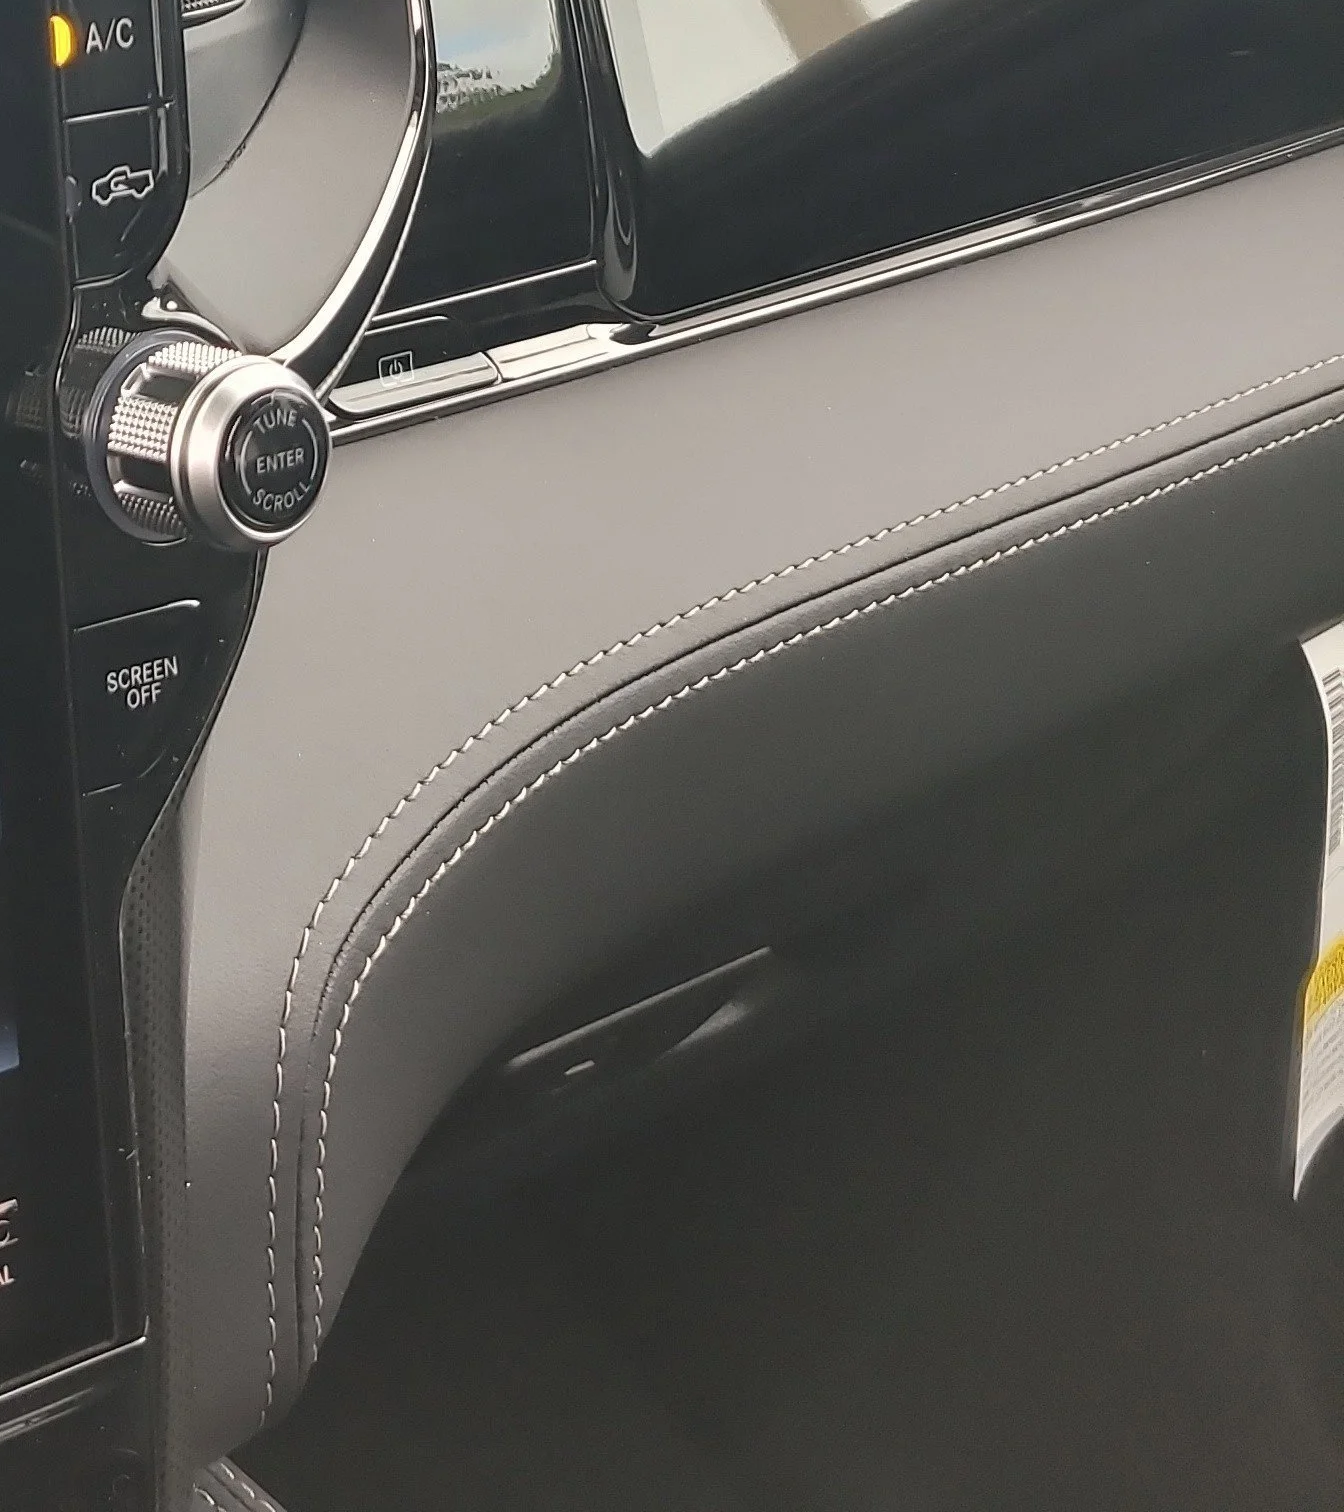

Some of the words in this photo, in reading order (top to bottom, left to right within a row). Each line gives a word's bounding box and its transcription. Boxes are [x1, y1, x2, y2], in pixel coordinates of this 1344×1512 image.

[85, 18, 135, 54] A/C
[252, 407, 298, 434] TUNE
[256, 447, 304, 475] ENTER
[252, 481, 311, 512] SCROLL
[106, 655, 179, 693] SCREEN
[125, 681, 163, 711] OFF
